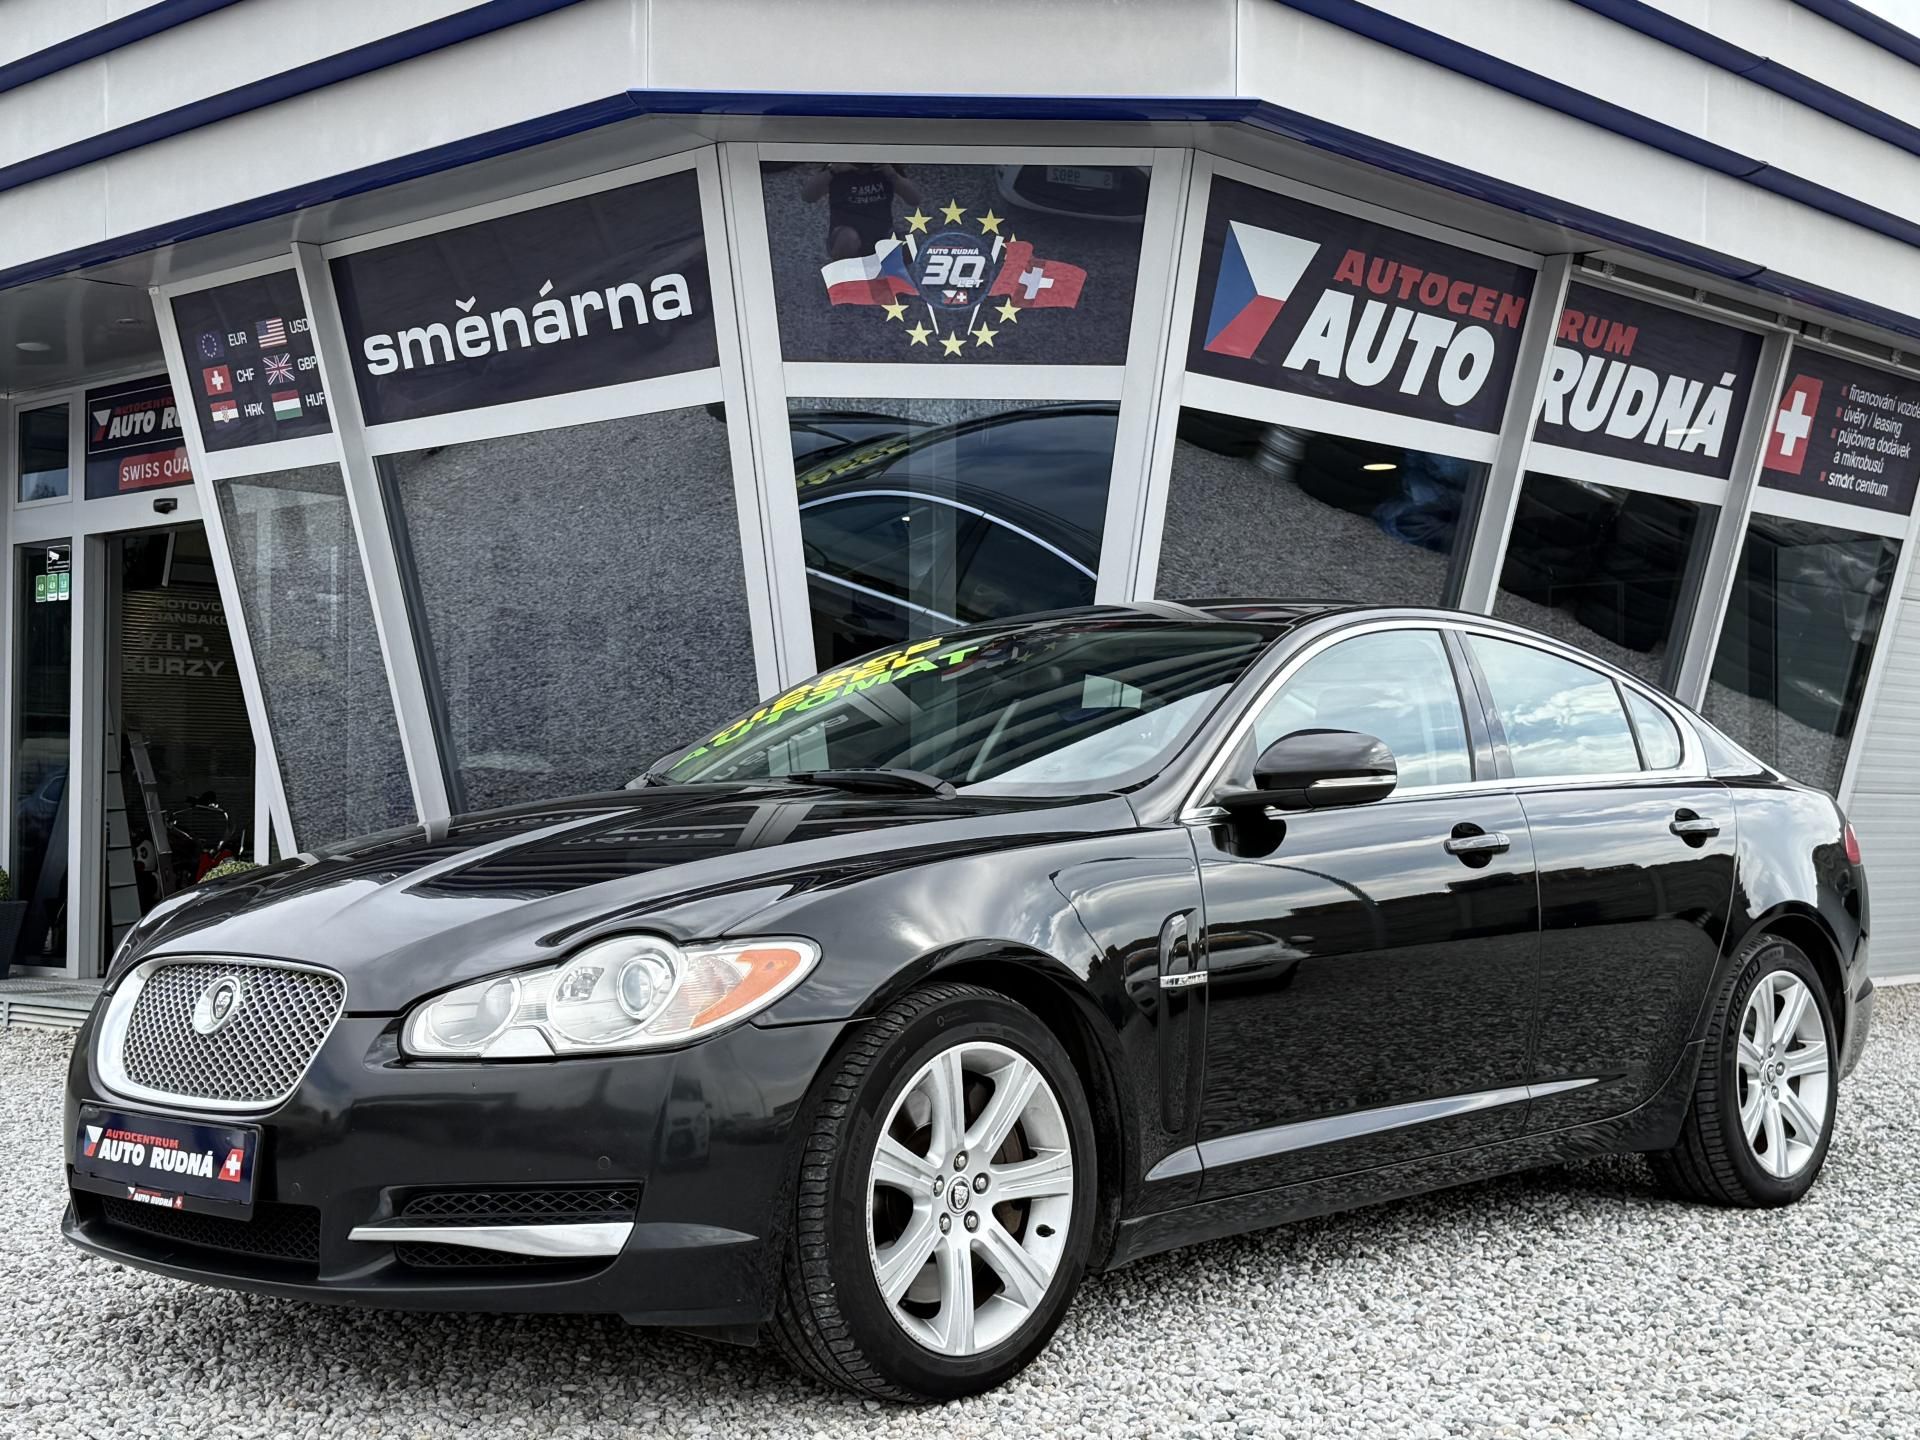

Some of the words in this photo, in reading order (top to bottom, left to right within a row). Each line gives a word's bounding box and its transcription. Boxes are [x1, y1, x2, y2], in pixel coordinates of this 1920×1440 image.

[951, 247, 979, 255] RUDNÁ
[921, 255, 985, 285] 30
[228, 331, 248, 347] EUR
[289, 319, 310, 334] USD
[363, 273, 693, 376] směnárna
[236, 368, 255, 383] CHF
[297, 356, 317, 371] GBP
[1282, 288, 1495, 406] AUTO
[1538, 345, 1737, 458] RUDNÁ
[244, 402, 265, 417] HRK
[305, 392, 325, 408] HUF
[1849, 384, 1897, 411] financování
[108, 410, 156, 439] AUTO
[1843, 405, 1868, 430] úvěry
[1872, 412, 1903, 439] leasing
[1833, 451, 1841, 464] a
[1876, 436, 1911, 459] dodávek
[122, 462, 160, 482] SWISS
[163, 456, 191, 477] QUA
[1855, 479, 1889, 497] centrum
[668, 645, 979, 771] AUTOMAT
[105, 1128, 180, 1149] AUTOCENTRUM
[98, 1138, 146, 1166] AUTO
[149, 1147, 214, 1178] RUDNÁ
[133, 1192, 150, 1203] AUTO
[150, 1195, 173, 1207] RUDNÁ
